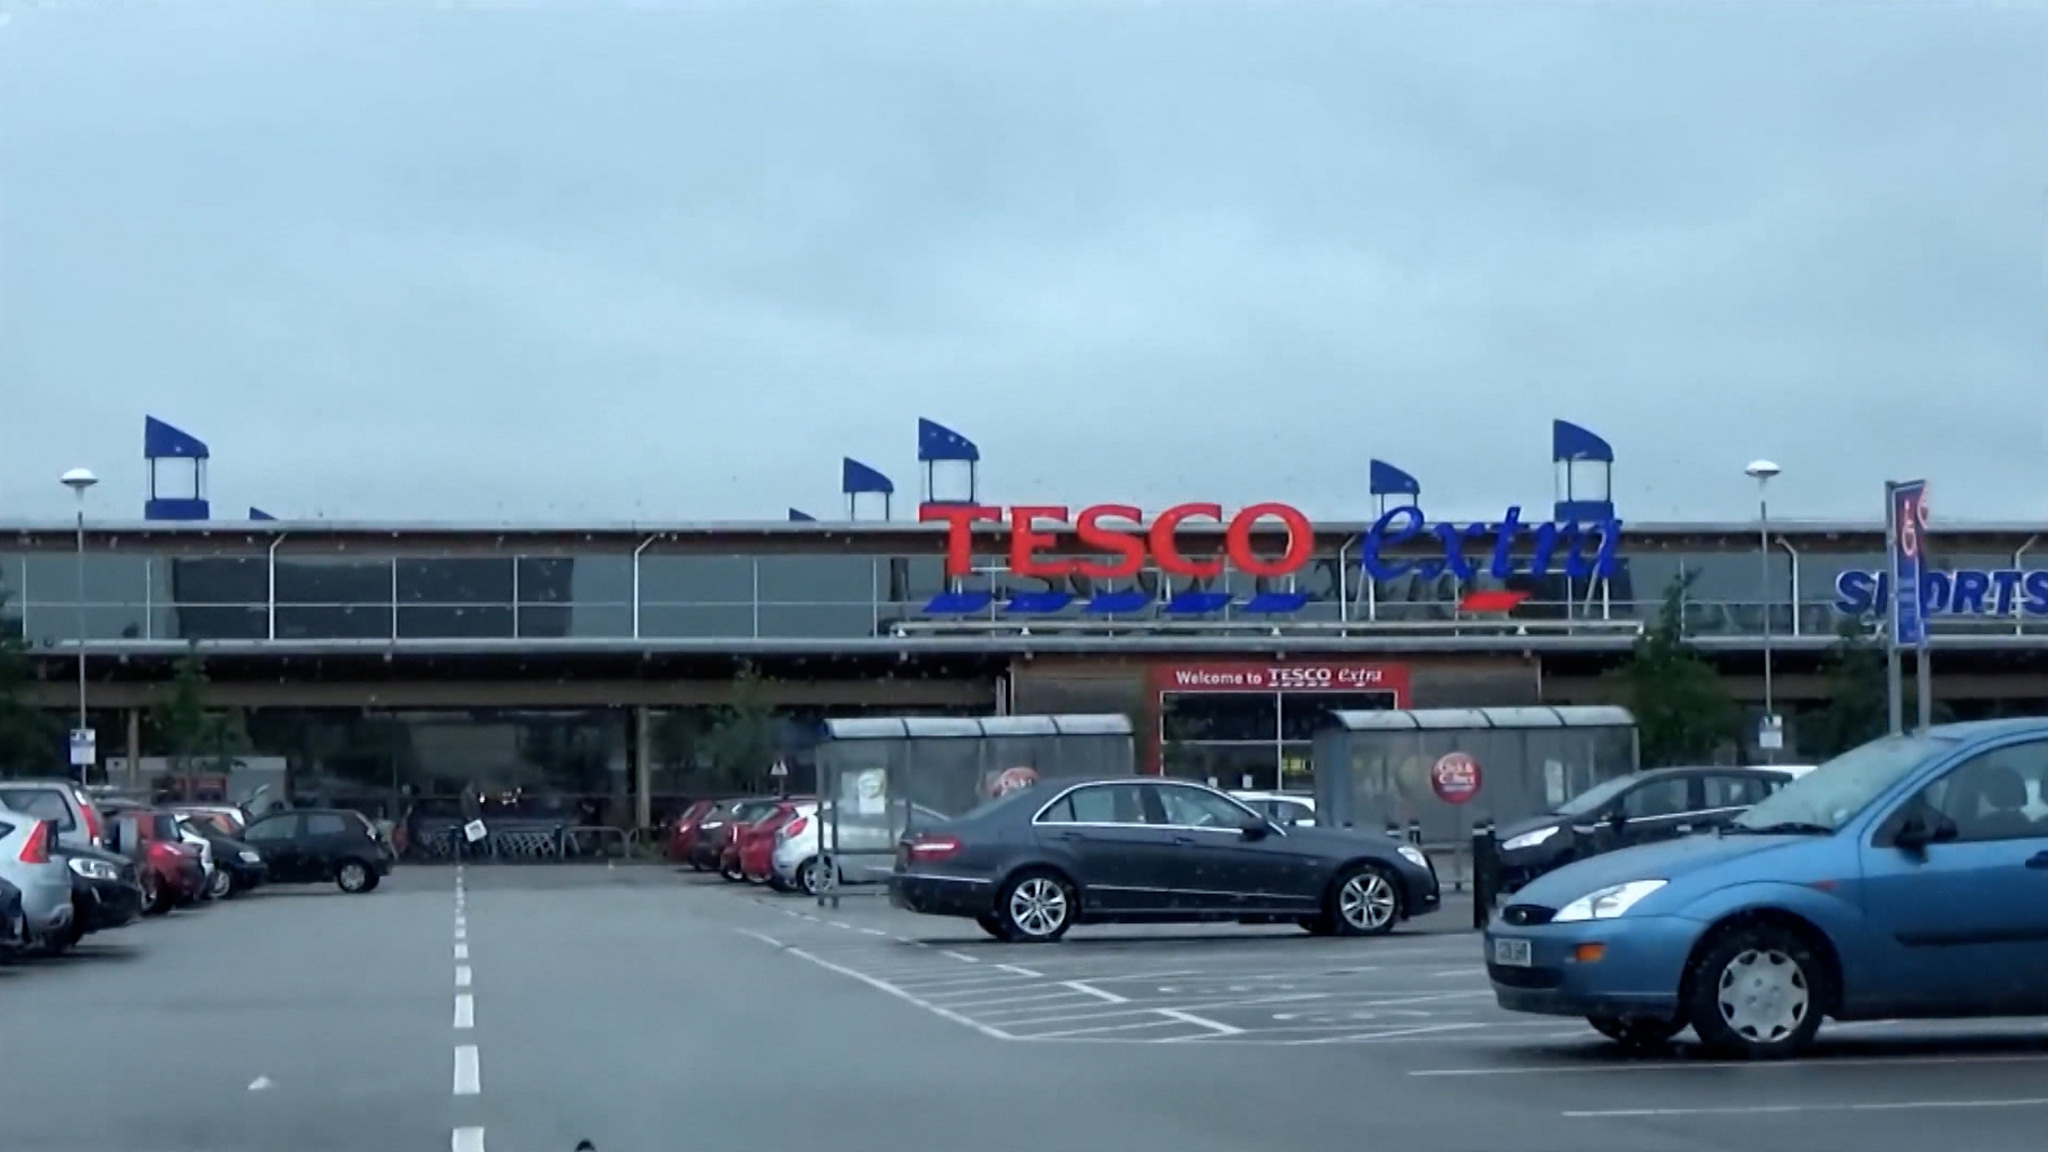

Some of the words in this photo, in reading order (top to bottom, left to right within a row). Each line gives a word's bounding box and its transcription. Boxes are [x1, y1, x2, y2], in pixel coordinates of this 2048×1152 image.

[919, 502, 1314, 578] TESCO
[1361, 505, 1622, 580] extra
[1175, 670, 1244, 685] Welcome
[1247, 671, 1263, 685] to
[1267, 668, 1331, 683] TESCO
[1338, 668, 1382, 683] extra
